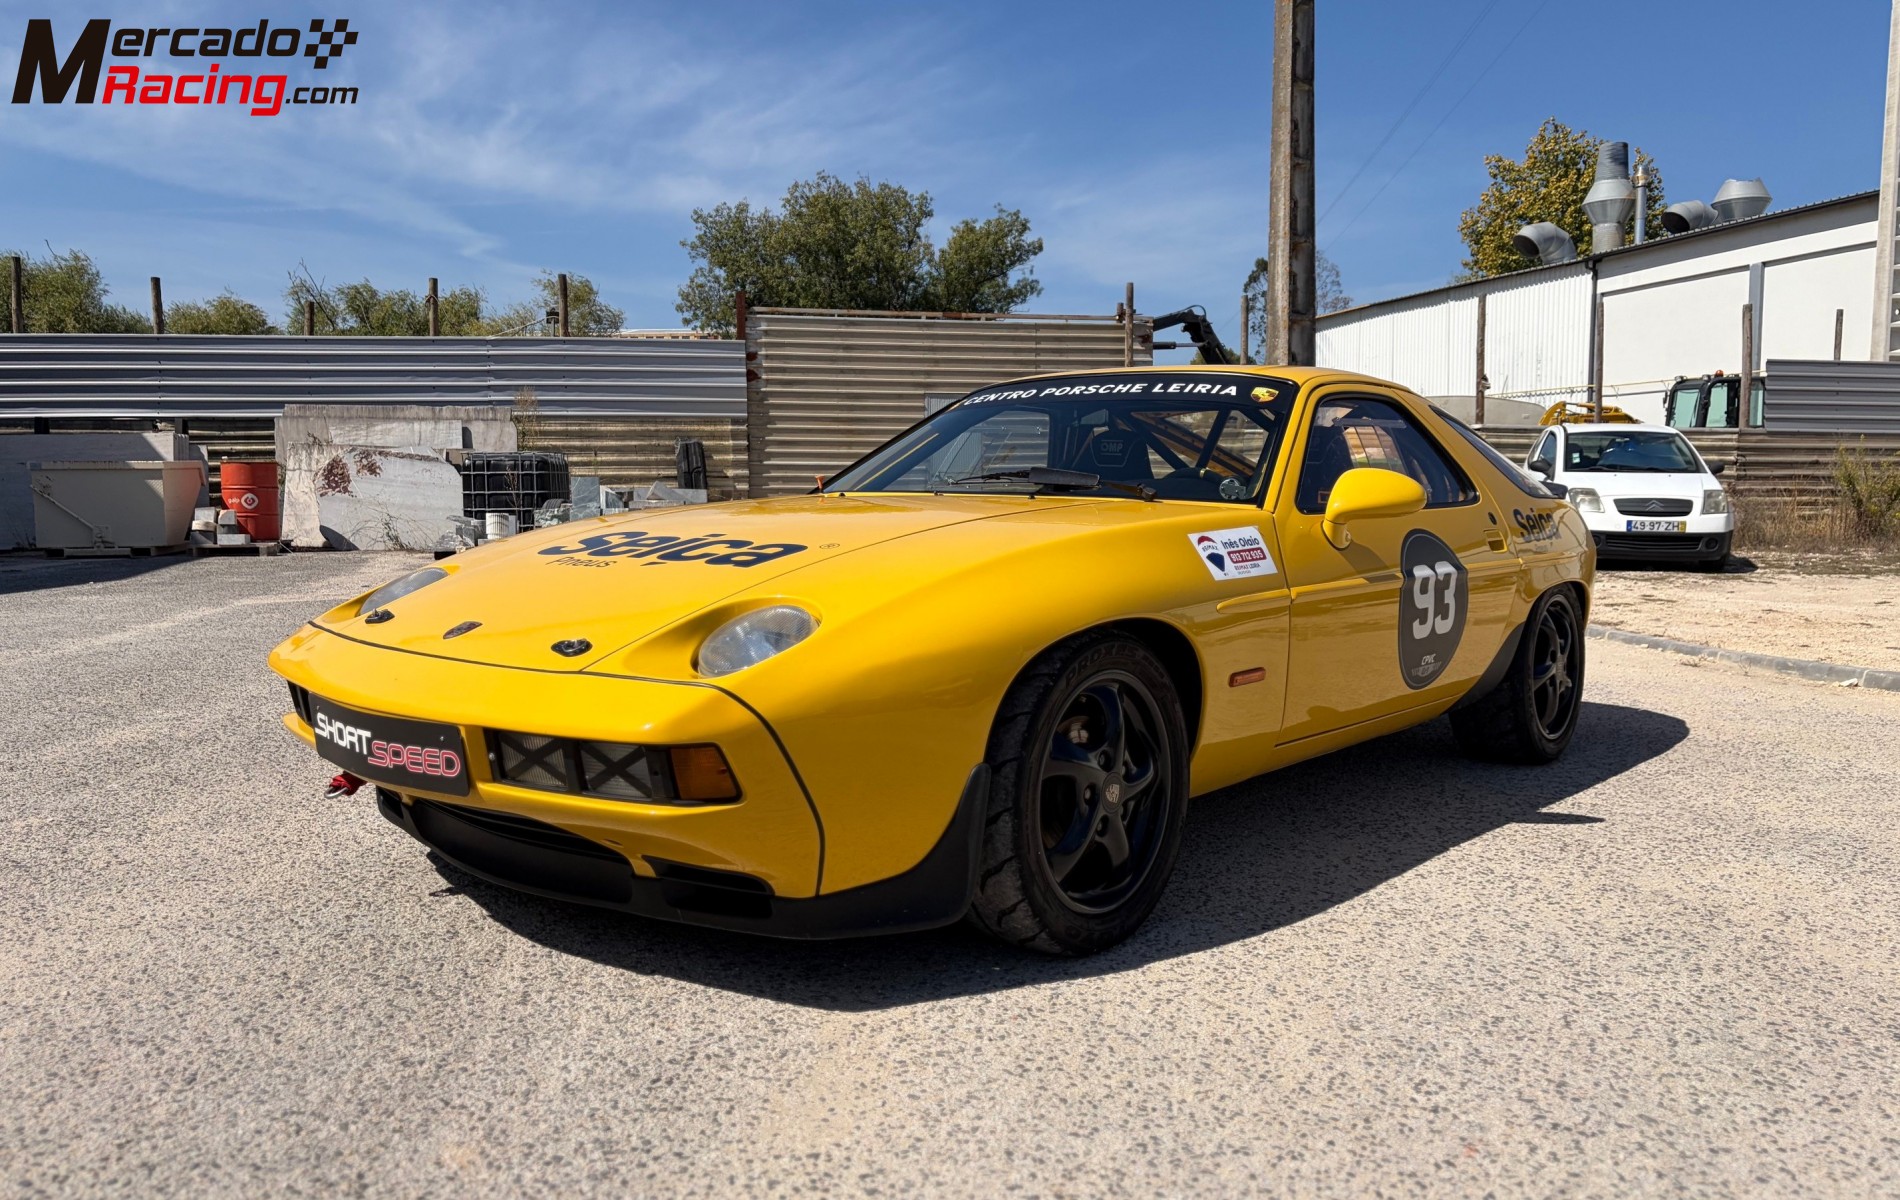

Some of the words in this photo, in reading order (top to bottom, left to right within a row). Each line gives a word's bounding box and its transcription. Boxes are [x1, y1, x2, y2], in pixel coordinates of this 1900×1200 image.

[963, 389, 1037, 406] CENTRO
[1040, 383, 1149, 398] PORSCHE
[1152, 383, 1238, 396] LEIRIA
[1101, 442, 1124, 453] OMP
[1221, 539, 1240, 549] Inês
[1412, 561, 1458, 640] 93
[314, 712, 373, 756] SHORT
[367, 740, 462, 778] SPEED
